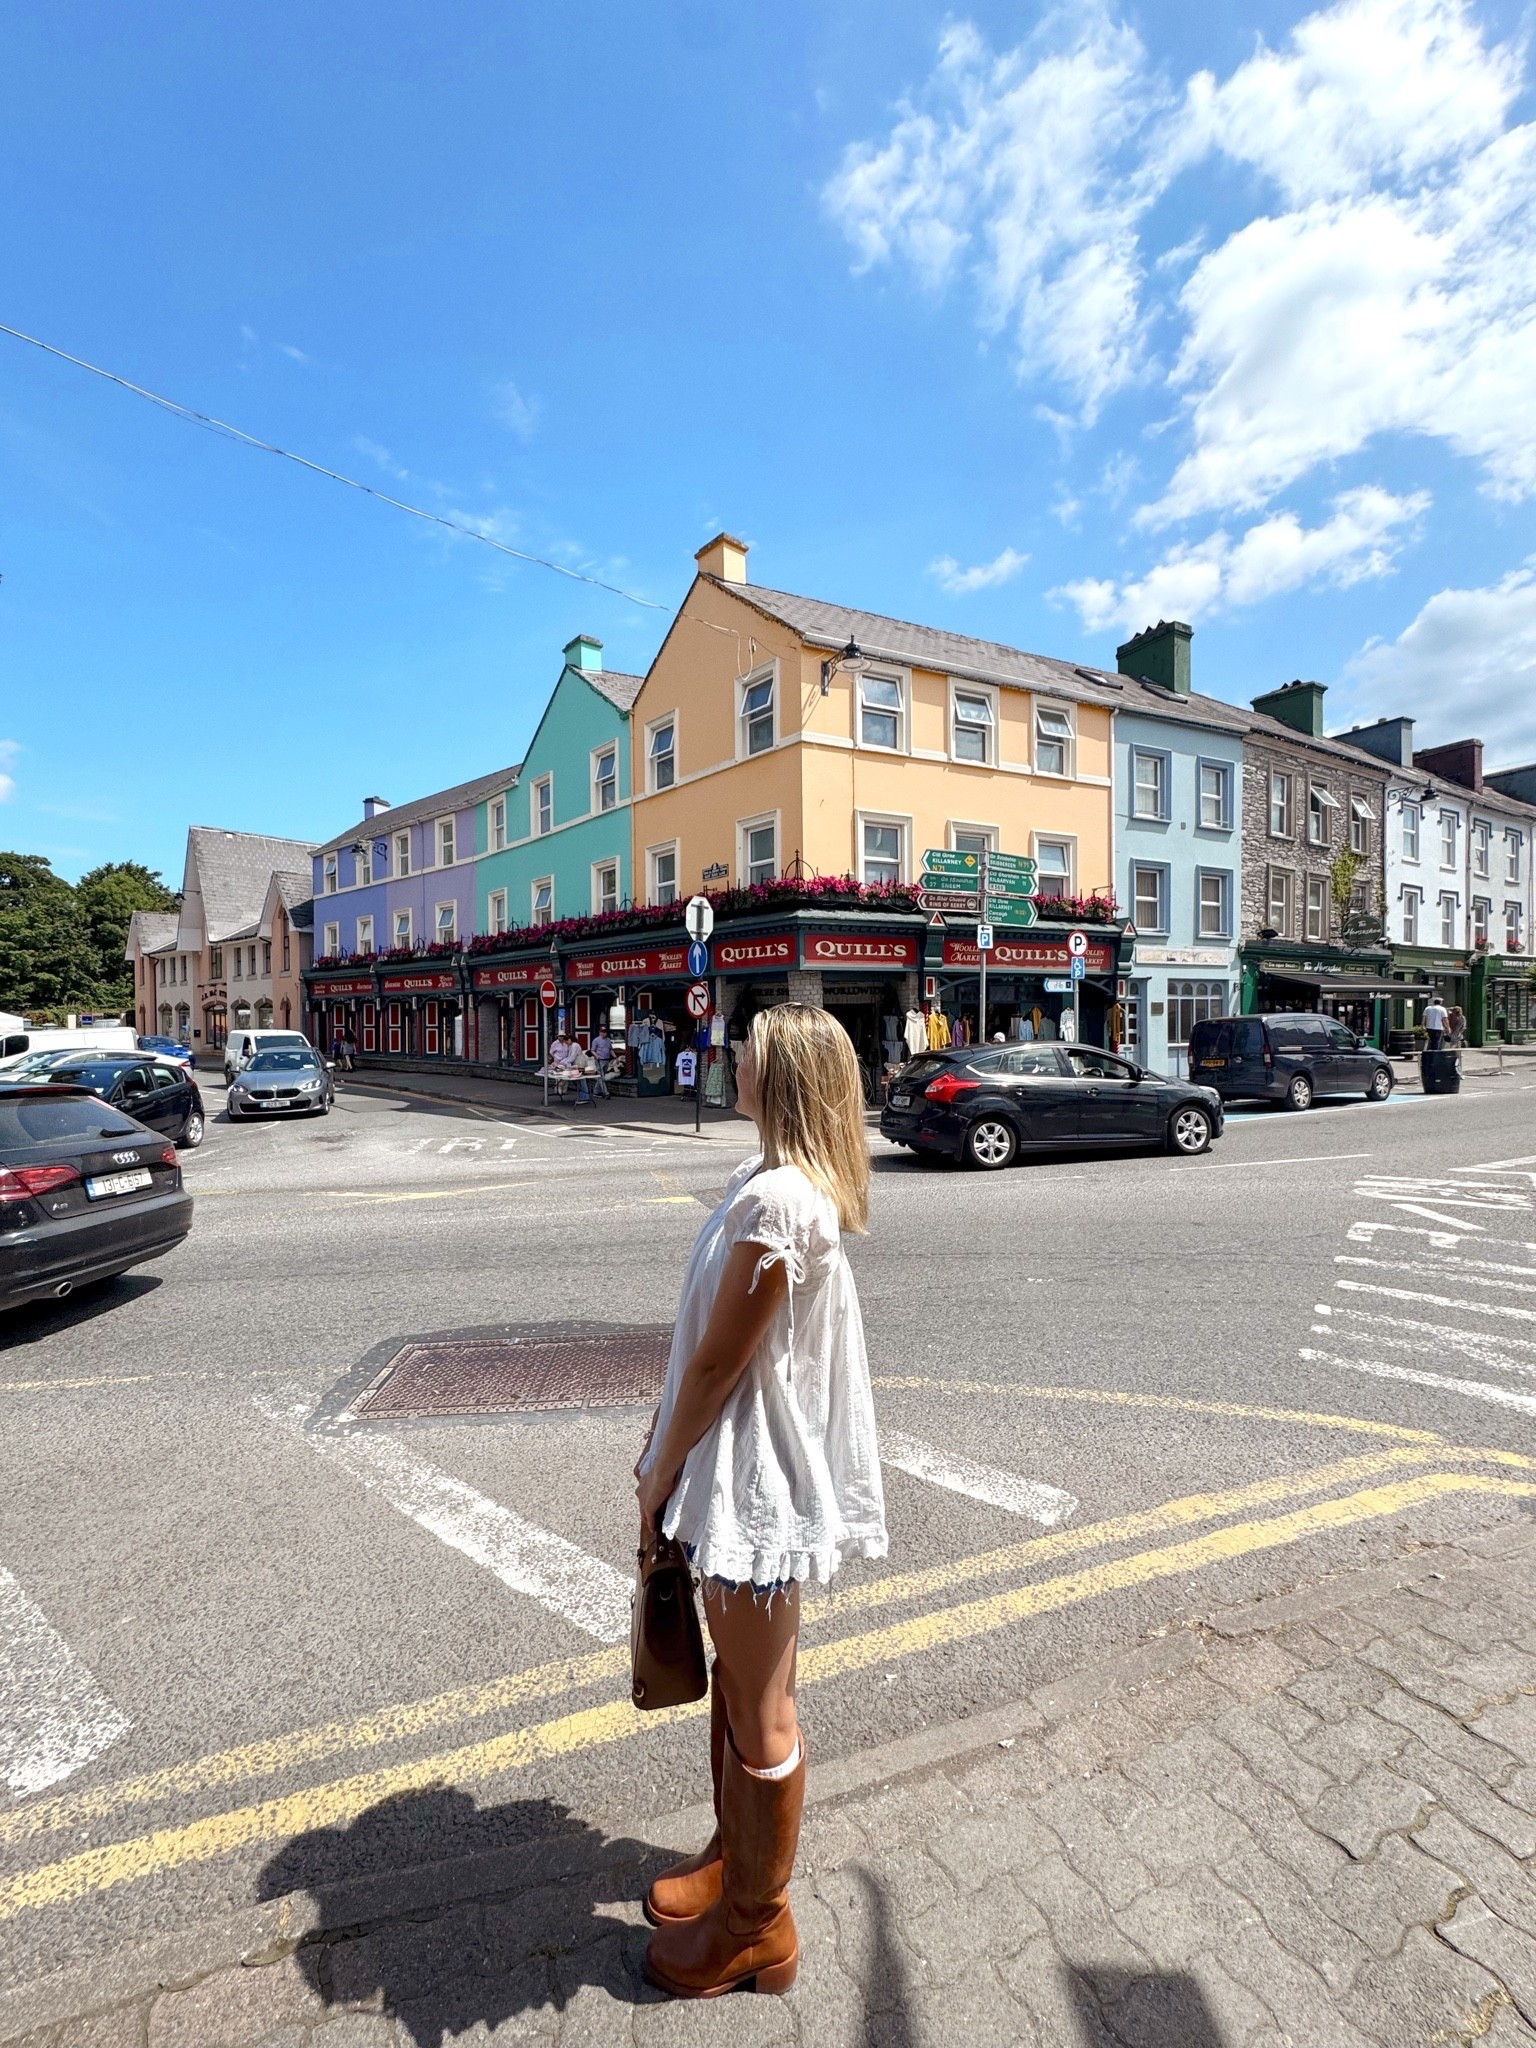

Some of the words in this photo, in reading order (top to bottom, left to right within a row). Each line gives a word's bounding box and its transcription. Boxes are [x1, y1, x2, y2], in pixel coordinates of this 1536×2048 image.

[982, 935, 988, 946] P
[1074, 936, 1083, 947] P
[720, 943, 789, 963] QUILL'S
[815, 940, 907, 957] QUILL'S
[994, 946, 1068, 961] QUILL'S
[658, 953, 683, 962] WOOLLEN
[601, 958, 646, 973] QUILL'S
[658, 961, 682, 970] MARKET
[497, 971, 528, 982] QUILL'S
[330, 984, 352, 992] QUILL'S
[404, 979, 432, 988] QUILL'S
